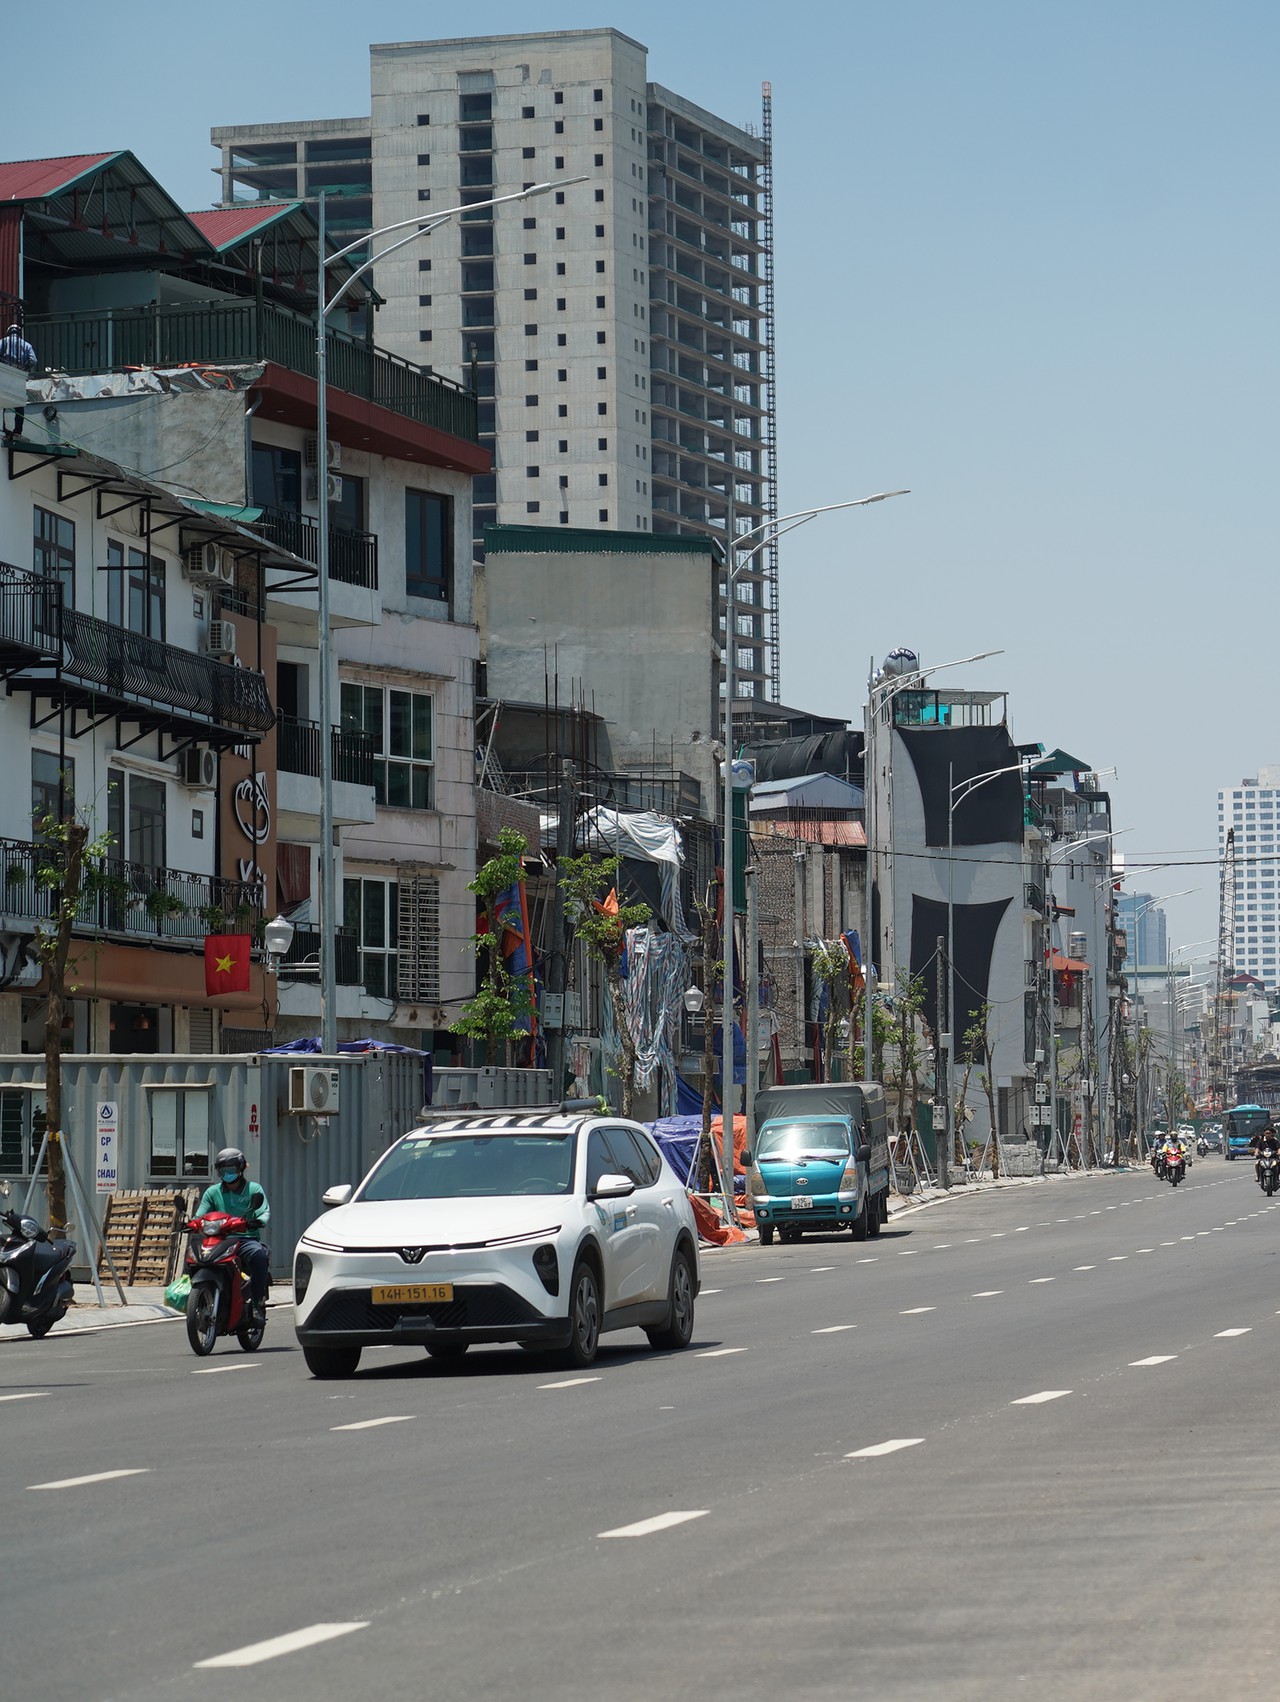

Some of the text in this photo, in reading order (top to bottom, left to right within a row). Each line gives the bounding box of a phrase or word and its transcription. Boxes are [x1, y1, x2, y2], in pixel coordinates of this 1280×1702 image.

[100, 1136, 111, 1146] CP
[102, 1153, 109, 1162] A
[97, 1169, 116, 1179] CHAU
[380, 1287, 446, 1300] 14H-151.16
